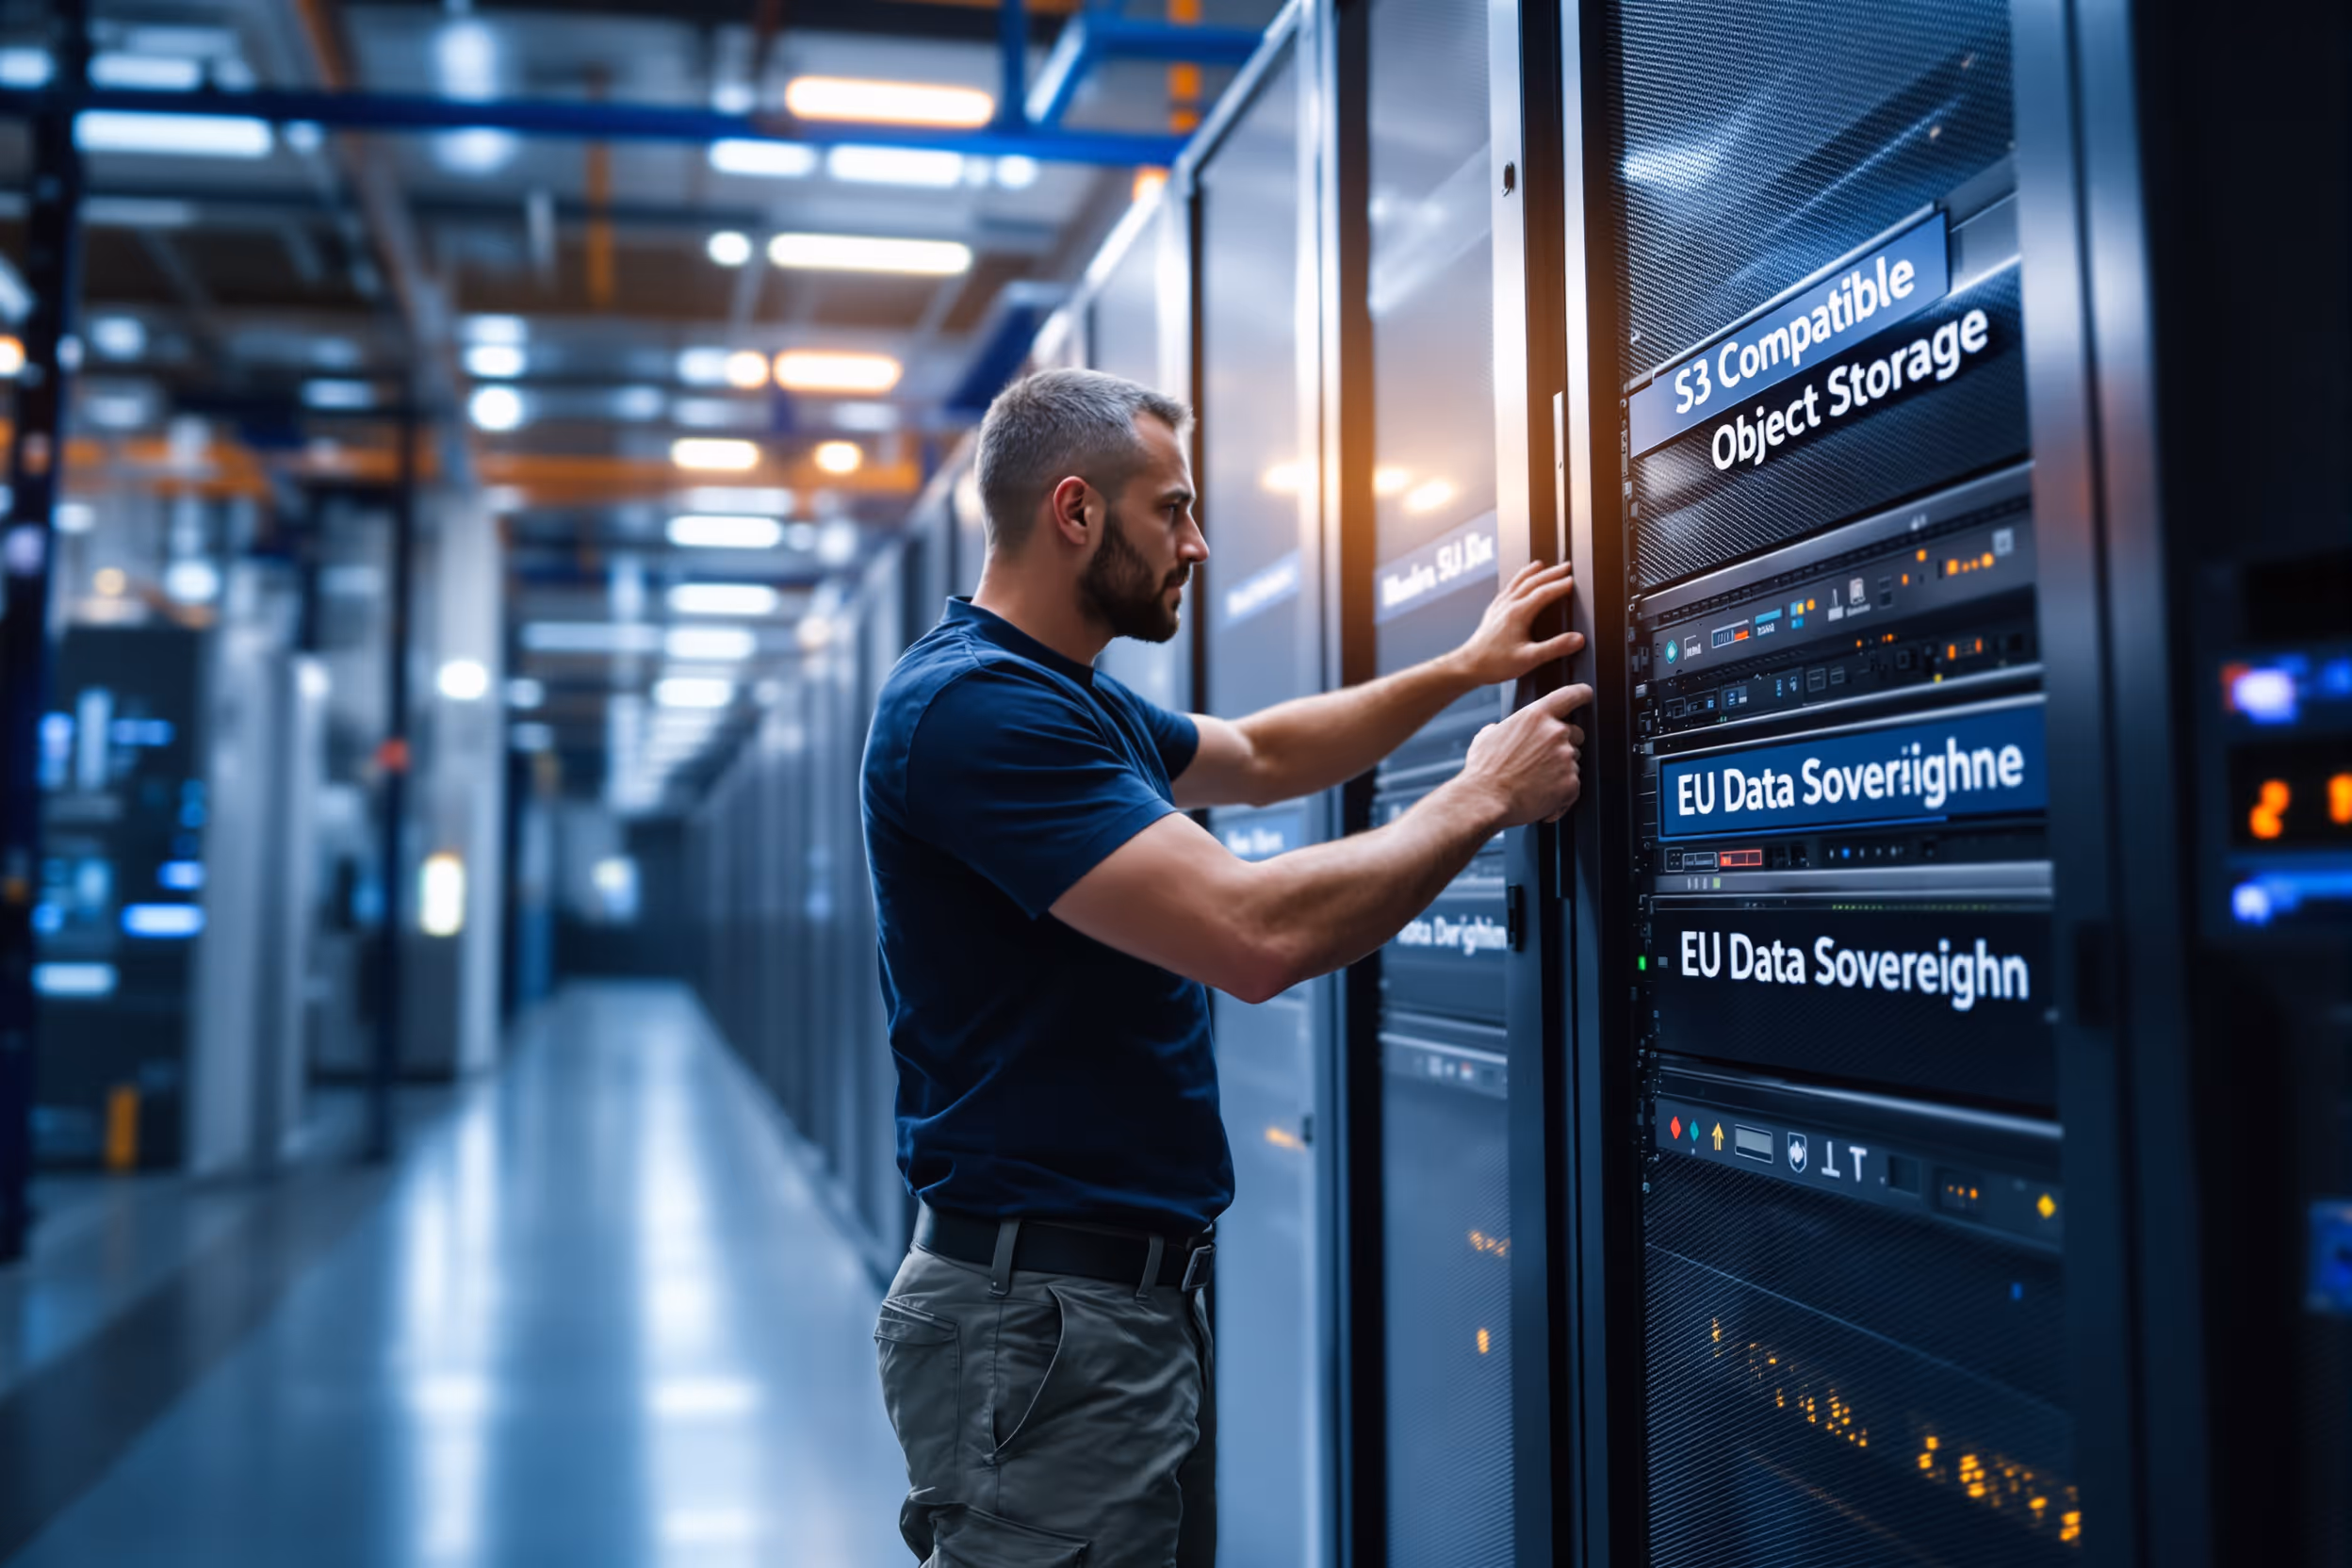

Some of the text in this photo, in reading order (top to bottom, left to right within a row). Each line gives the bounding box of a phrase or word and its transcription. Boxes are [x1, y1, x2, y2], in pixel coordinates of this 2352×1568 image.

[1674, 255, 1916, 415] S3 Compatible
[1711, 309, 1988, 470] Object Storage
[1677, 771, 1716, 816] EU
[1723, 767, 1795, 812] Data
[1681, 930, 2029, 1010] EU Data Sovereighn
